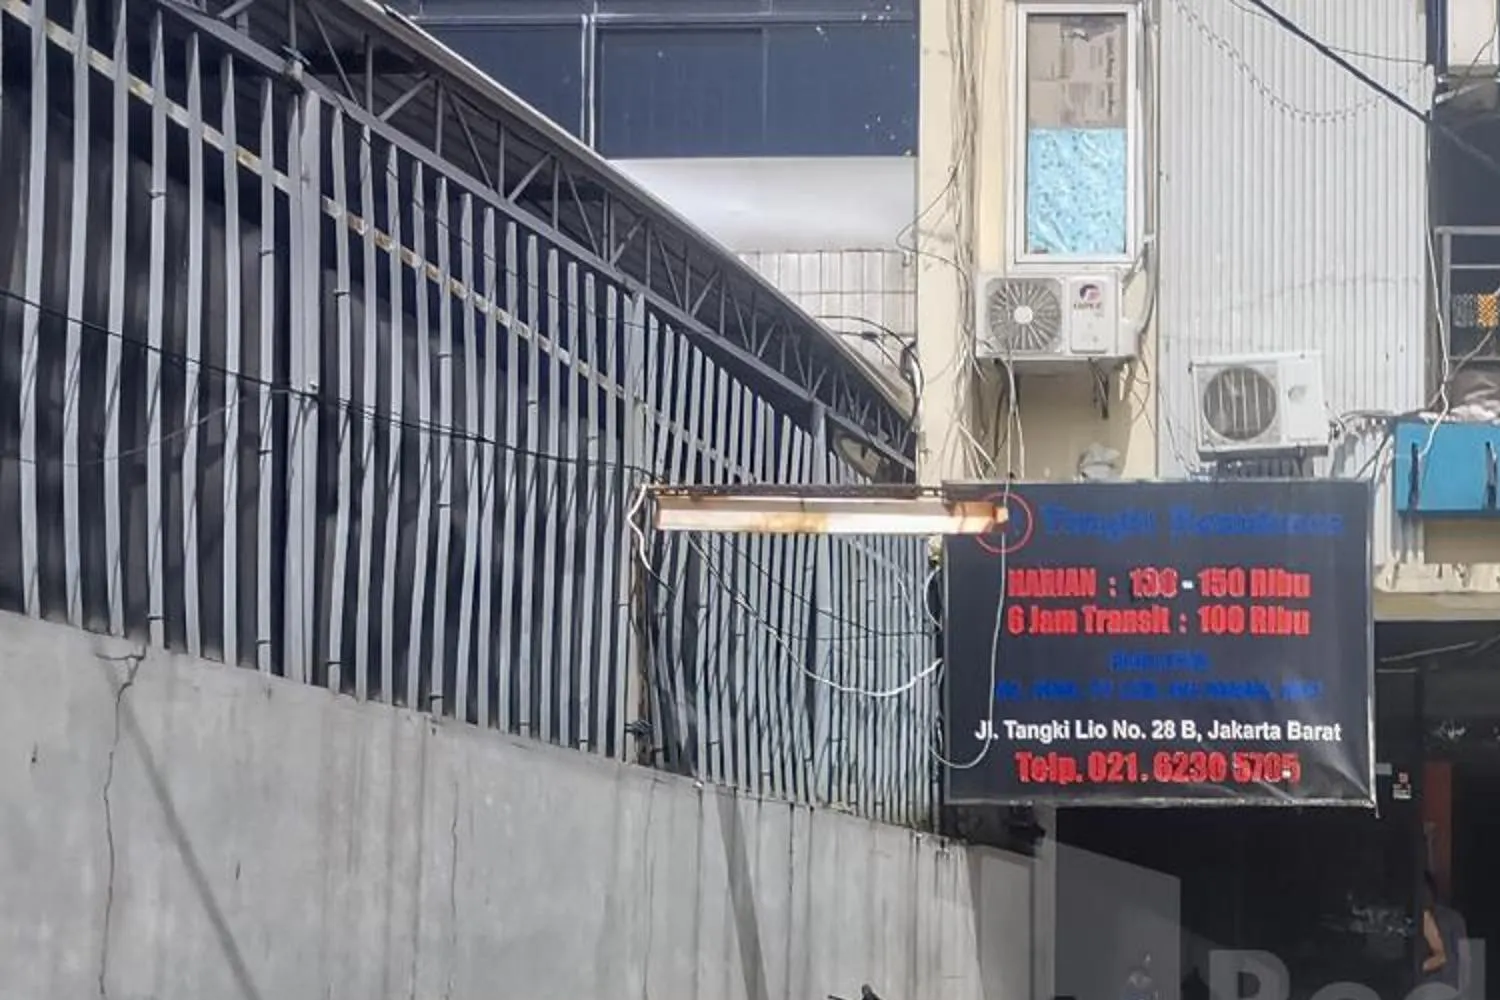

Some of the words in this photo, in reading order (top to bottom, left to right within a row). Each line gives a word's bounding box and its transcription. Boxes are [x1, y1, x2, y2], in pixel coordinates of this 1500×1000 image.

[1007, 568, 1096, 597] HARIAN
[1198, 567, 1246, 597] 150
[1007, 605, 1025, 634] 6
[1028, 606, 1078, 634] Jam
[1082, 605, 1171, 634] Transit
[1198, 605, 1246, 634] 100
[975, 722, 999, 740] Jl.
[1004, 720, 1070, 744] Tangki
[1076, 720, 1108, 740] Lio
[1113, 720, 1146, 740] No.
[1151, 720, 1176, 739] 28
[1181, 720, 1202, 743] B,
[1207, 720, 1281, 741] Jakarta
[1287, 721, 1342, 742] Barat
[1016, 752, 1083, 784] Telp.
